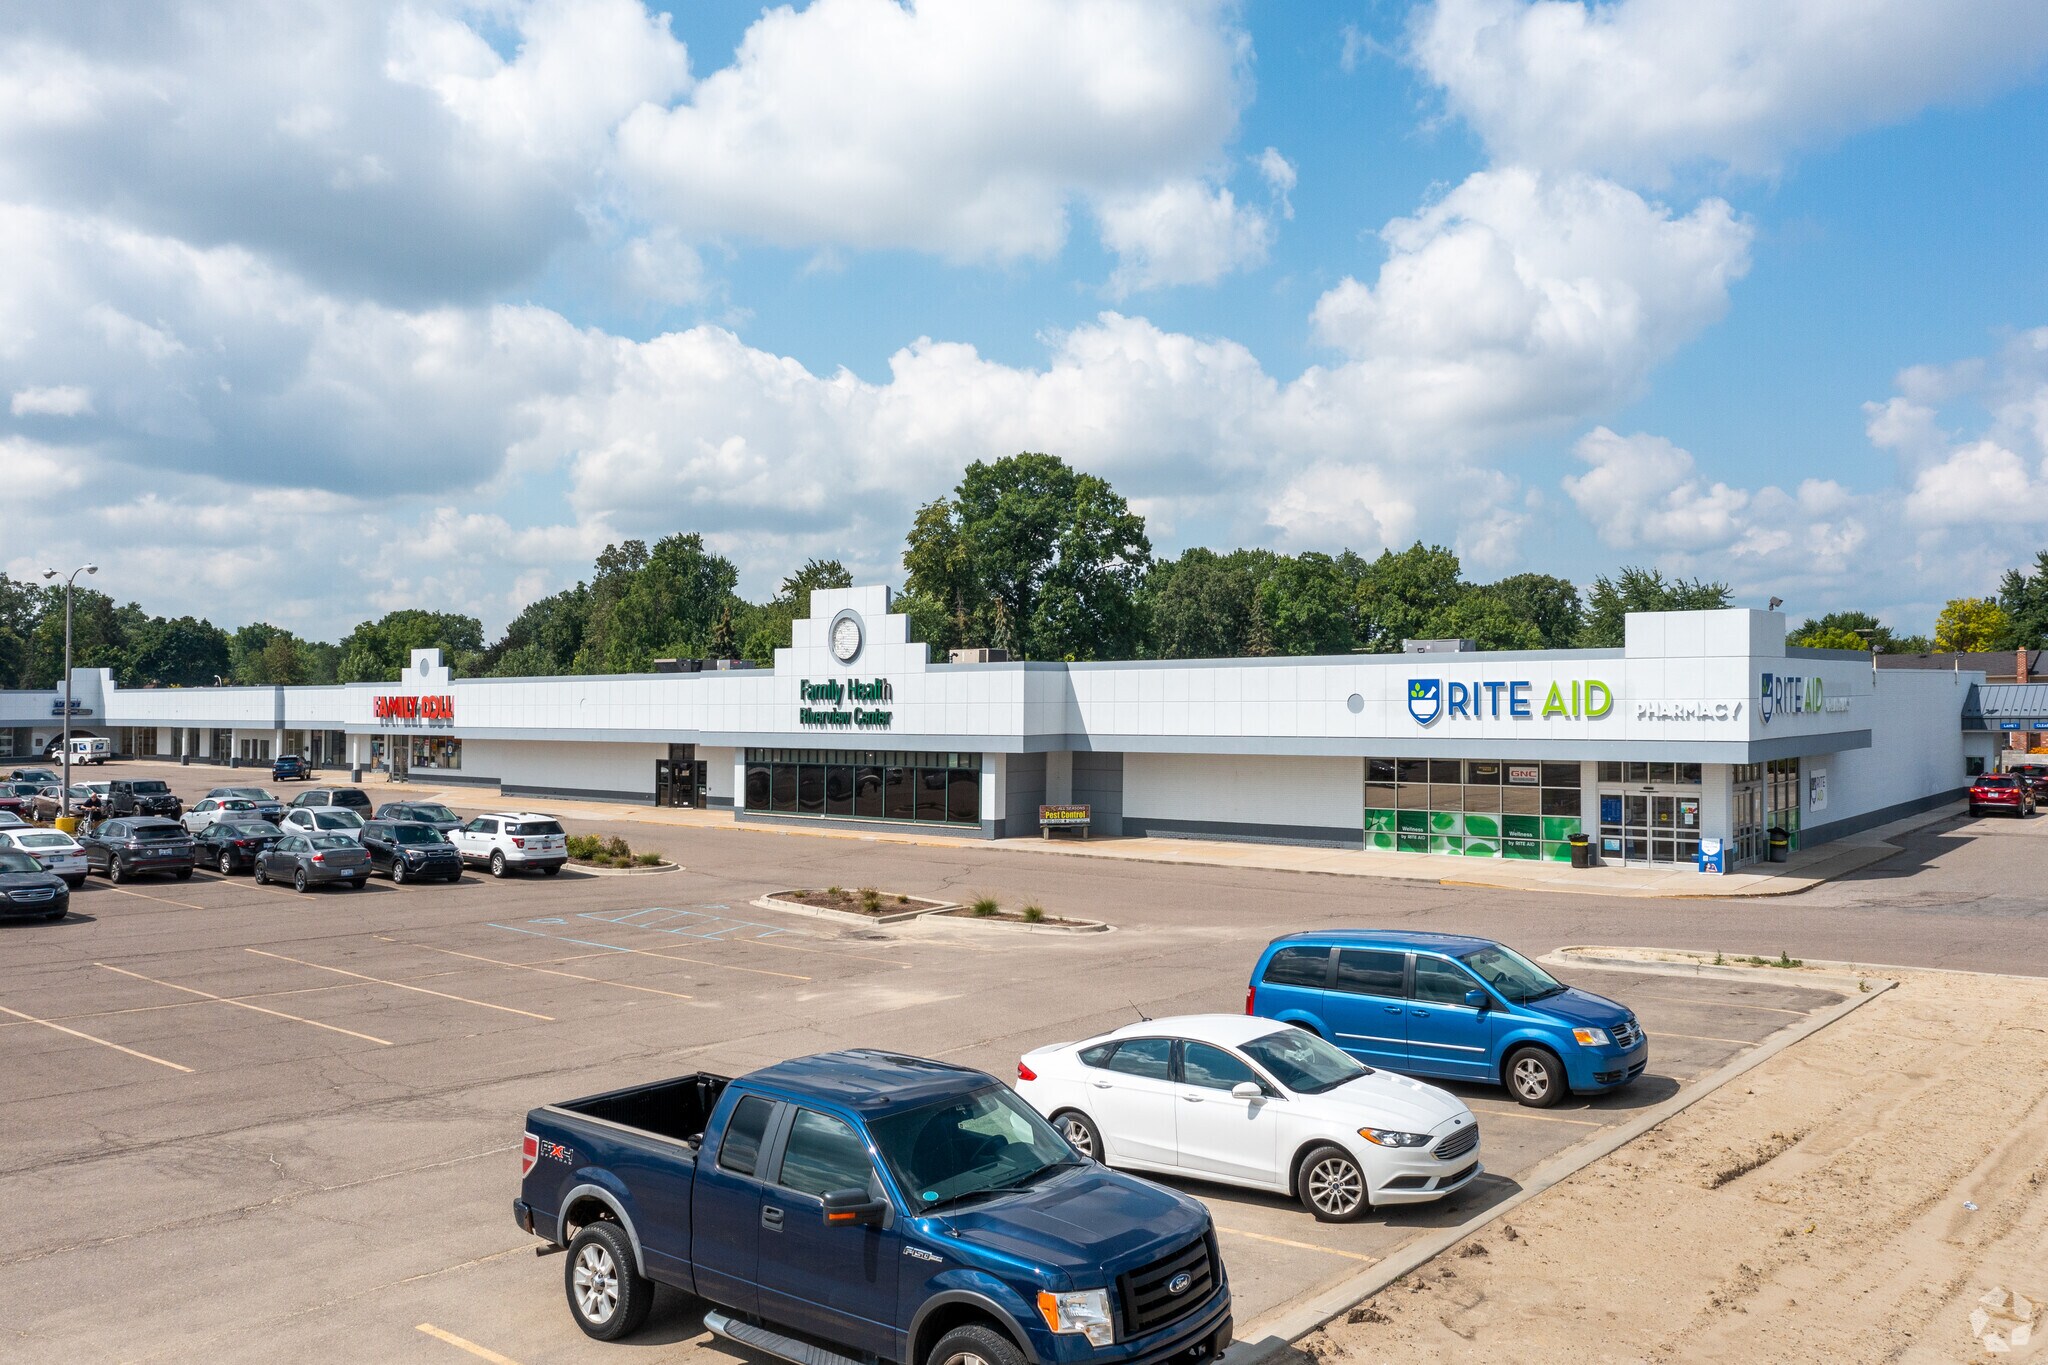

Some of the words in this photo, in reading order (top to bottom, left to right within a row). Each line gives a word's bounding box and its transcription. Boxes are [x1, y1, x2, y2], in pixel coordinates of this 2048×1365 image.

[800, 679, 845, 705] Family
[847, 678, 893, 700] Health
[1448, 682, 1531, 716] RITE
[1541, 680, 1612, 717] AID
[1775, 677, 1802, 713] RITE
[1802, 677, 1823, 712] AID
[374, 696, 419, 718] FAMILY
[799, 707, 853, 724] Riverview
[854, 707, 892, 725] Center
[1637, 701, 1742, 721] PHARMACY
[1045, 811, 1060, 819] Pest
[1061, 810, 1086, 819] Control
